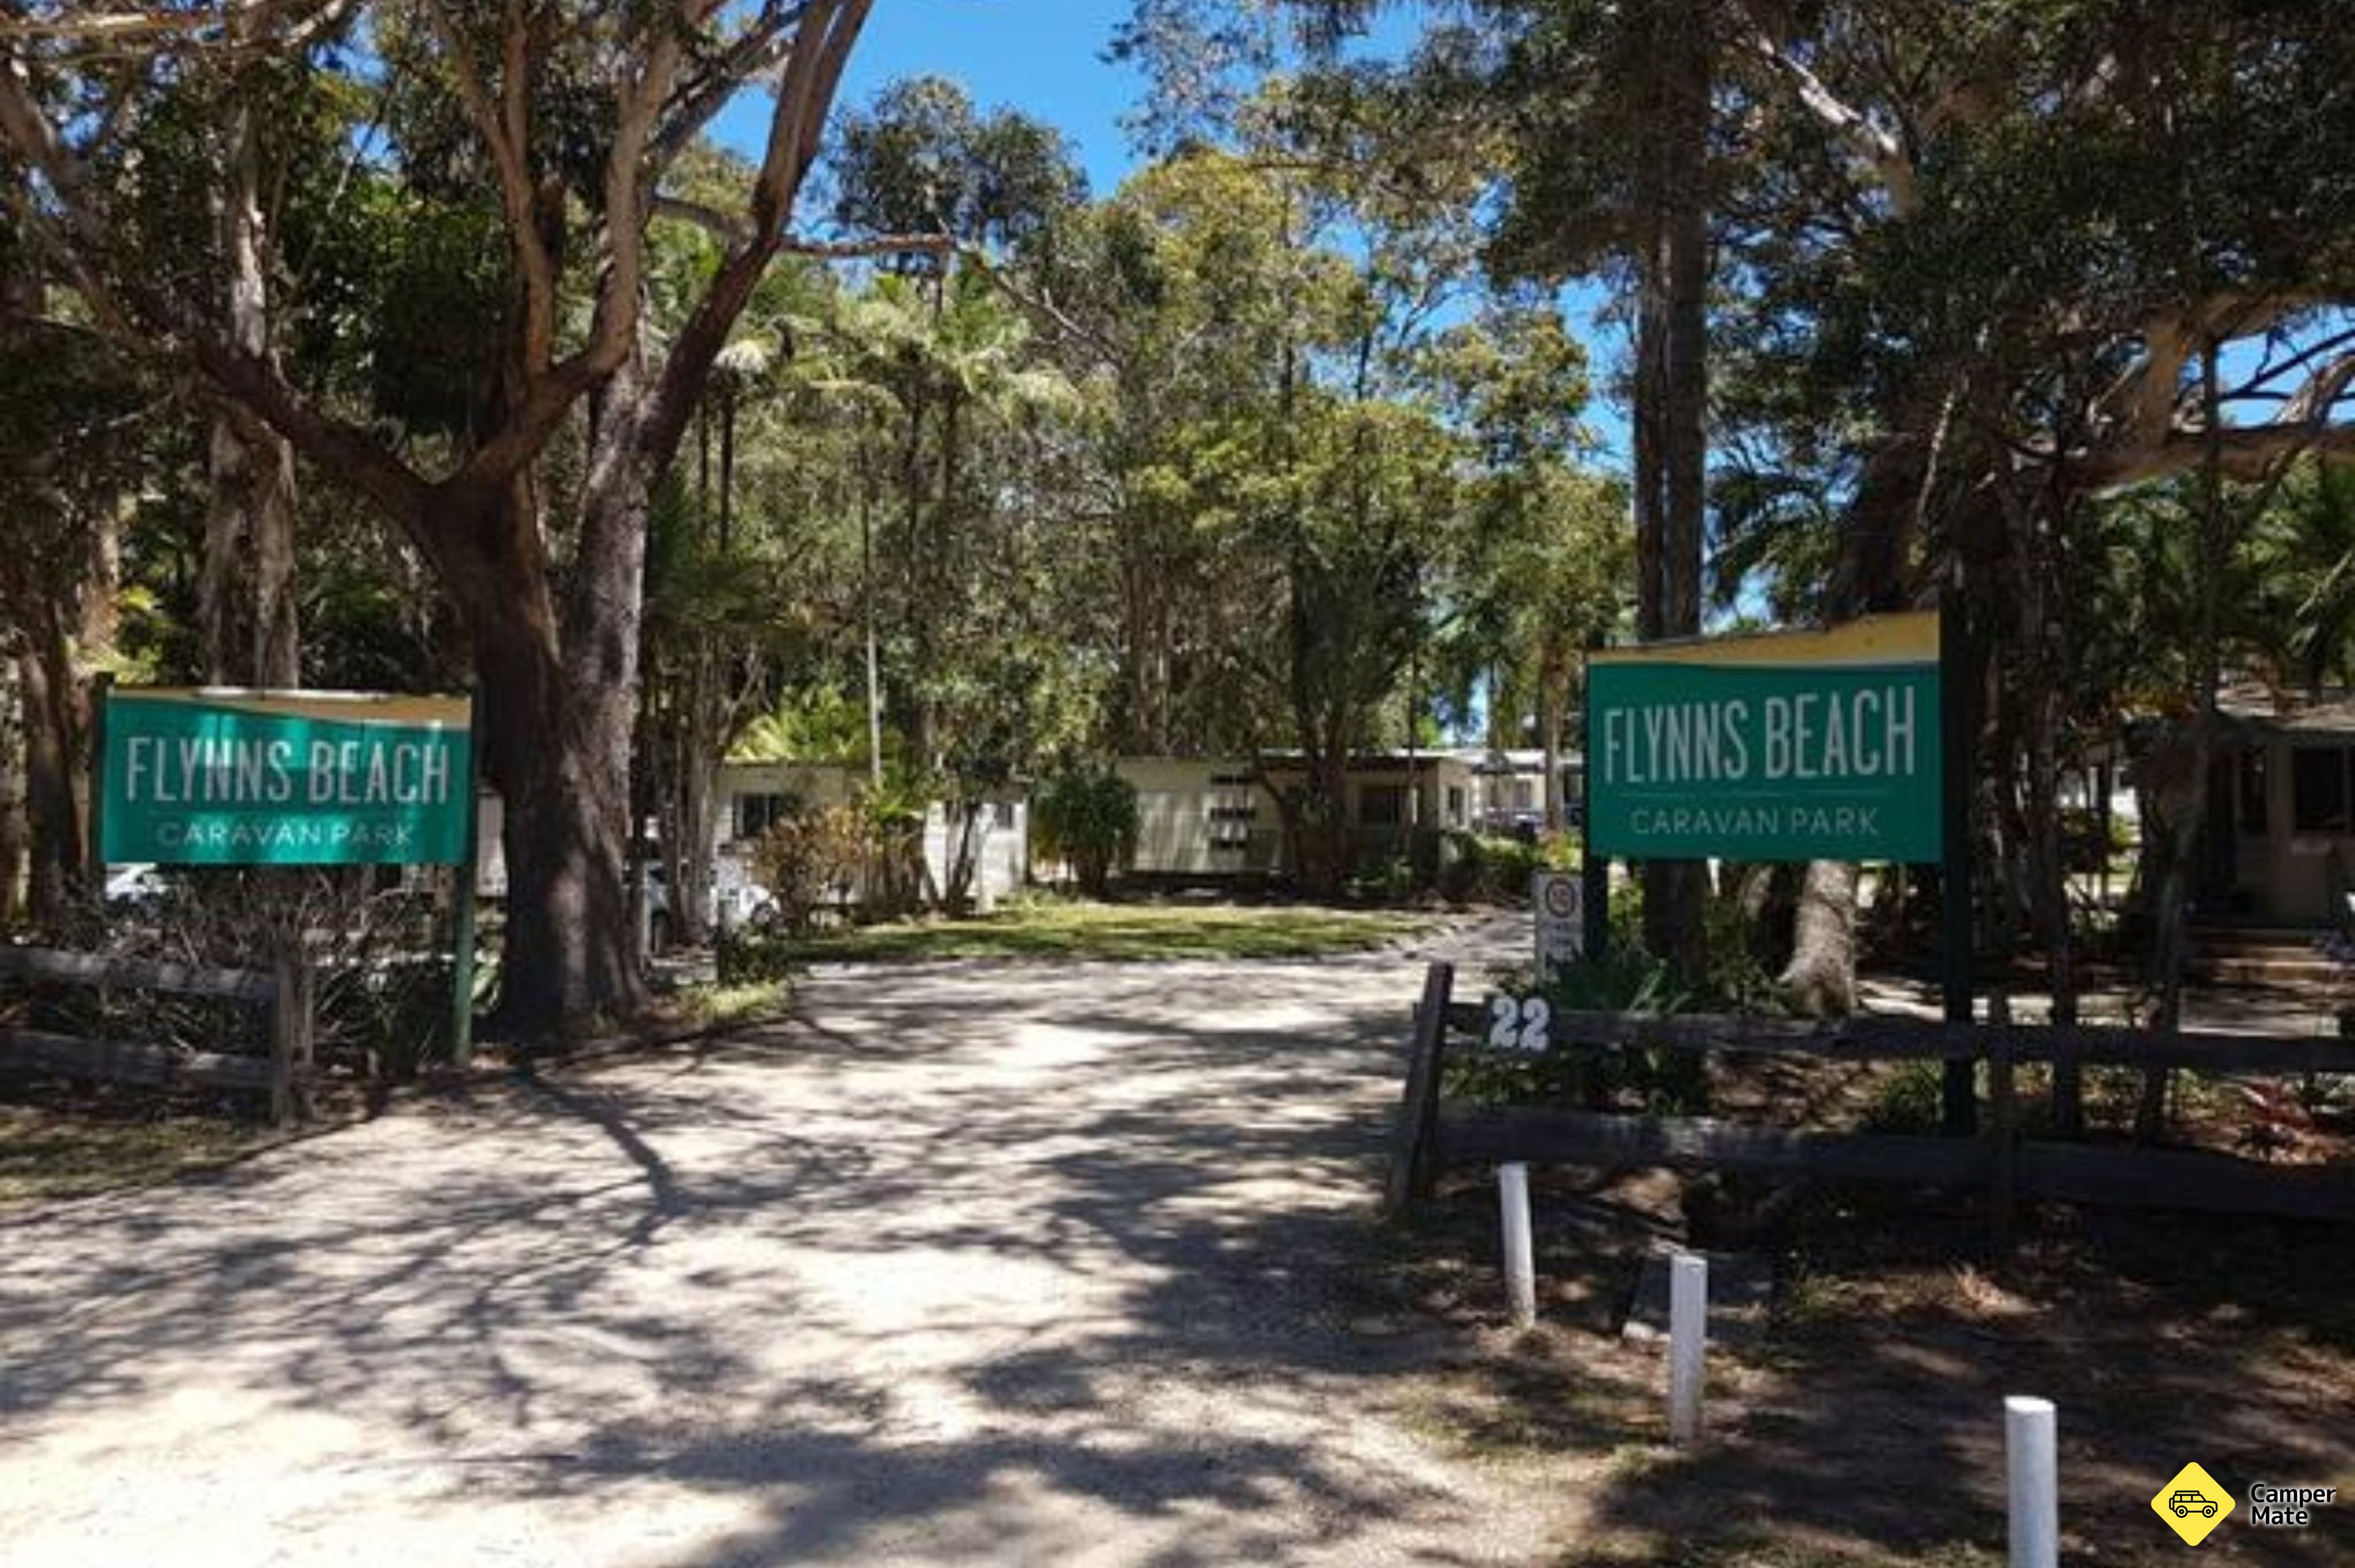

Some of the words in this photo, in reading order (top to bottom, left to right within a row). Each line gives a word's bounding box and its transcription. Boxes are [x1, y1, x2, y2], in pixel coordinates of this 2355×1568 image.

[1603, 699, 1749, 783] FLYNNS
[1766, 685, 1915, 779] BEACH
[127, 736, 293, 803] FLYNNS
[307, 739, 450, 805] BEACH
[157, 823, 321, 845] CARAVAN
[330, 823, 412, 845] PARK
[1630, 809, 1779, 835] CARAVAN
[1790, 807, 1880, 835] PARK
[1489, 995, 1550, 1052] 22
